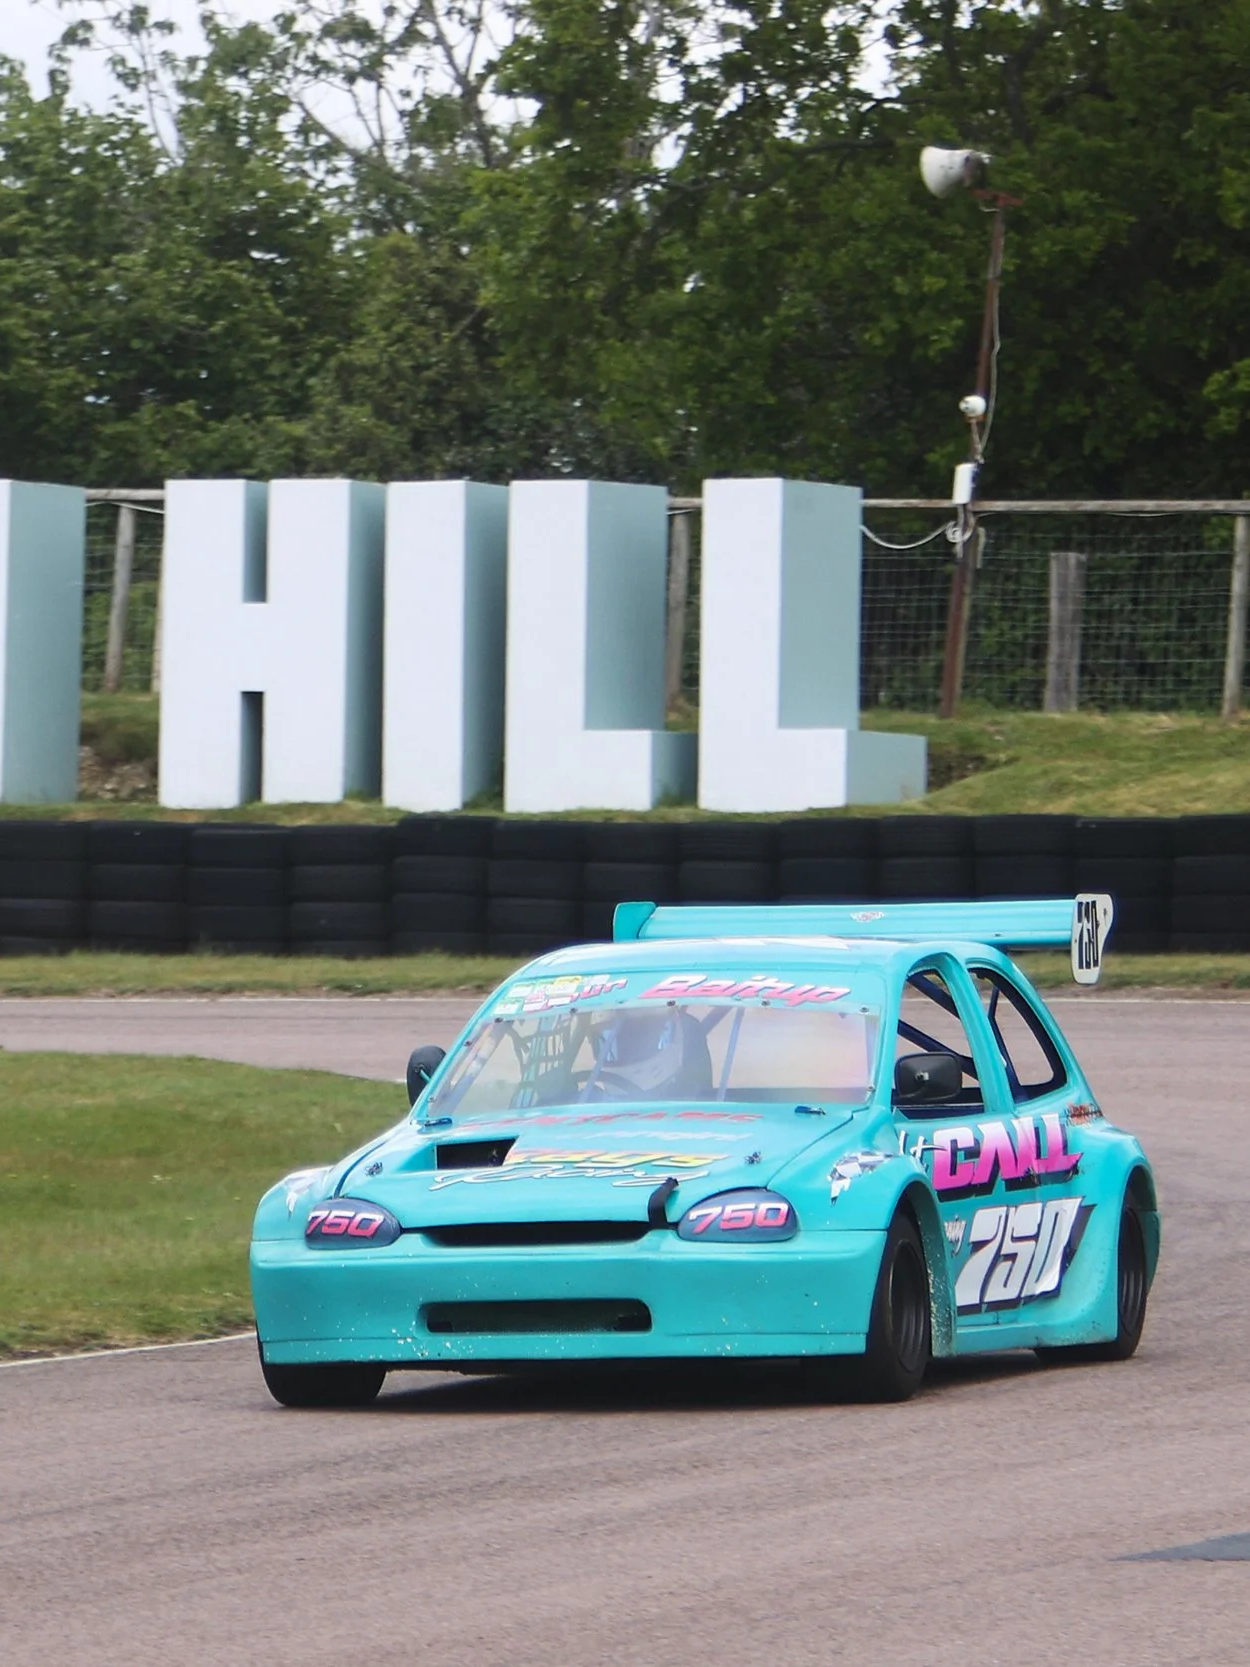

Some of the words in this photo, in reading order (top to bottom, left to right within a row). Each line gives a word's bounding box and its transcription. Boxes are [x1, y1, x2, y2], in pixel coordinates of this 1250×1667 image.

[158, 477, 850, 813] HILL
[1077, 900, 1099, 970] 750
[932, 1112, 1084, 1194] CALL
[305, 1209, 386, 1238] 750
[688, 1202, 790, 1235] 750
[955, 1196, 1084, 1309] 750
